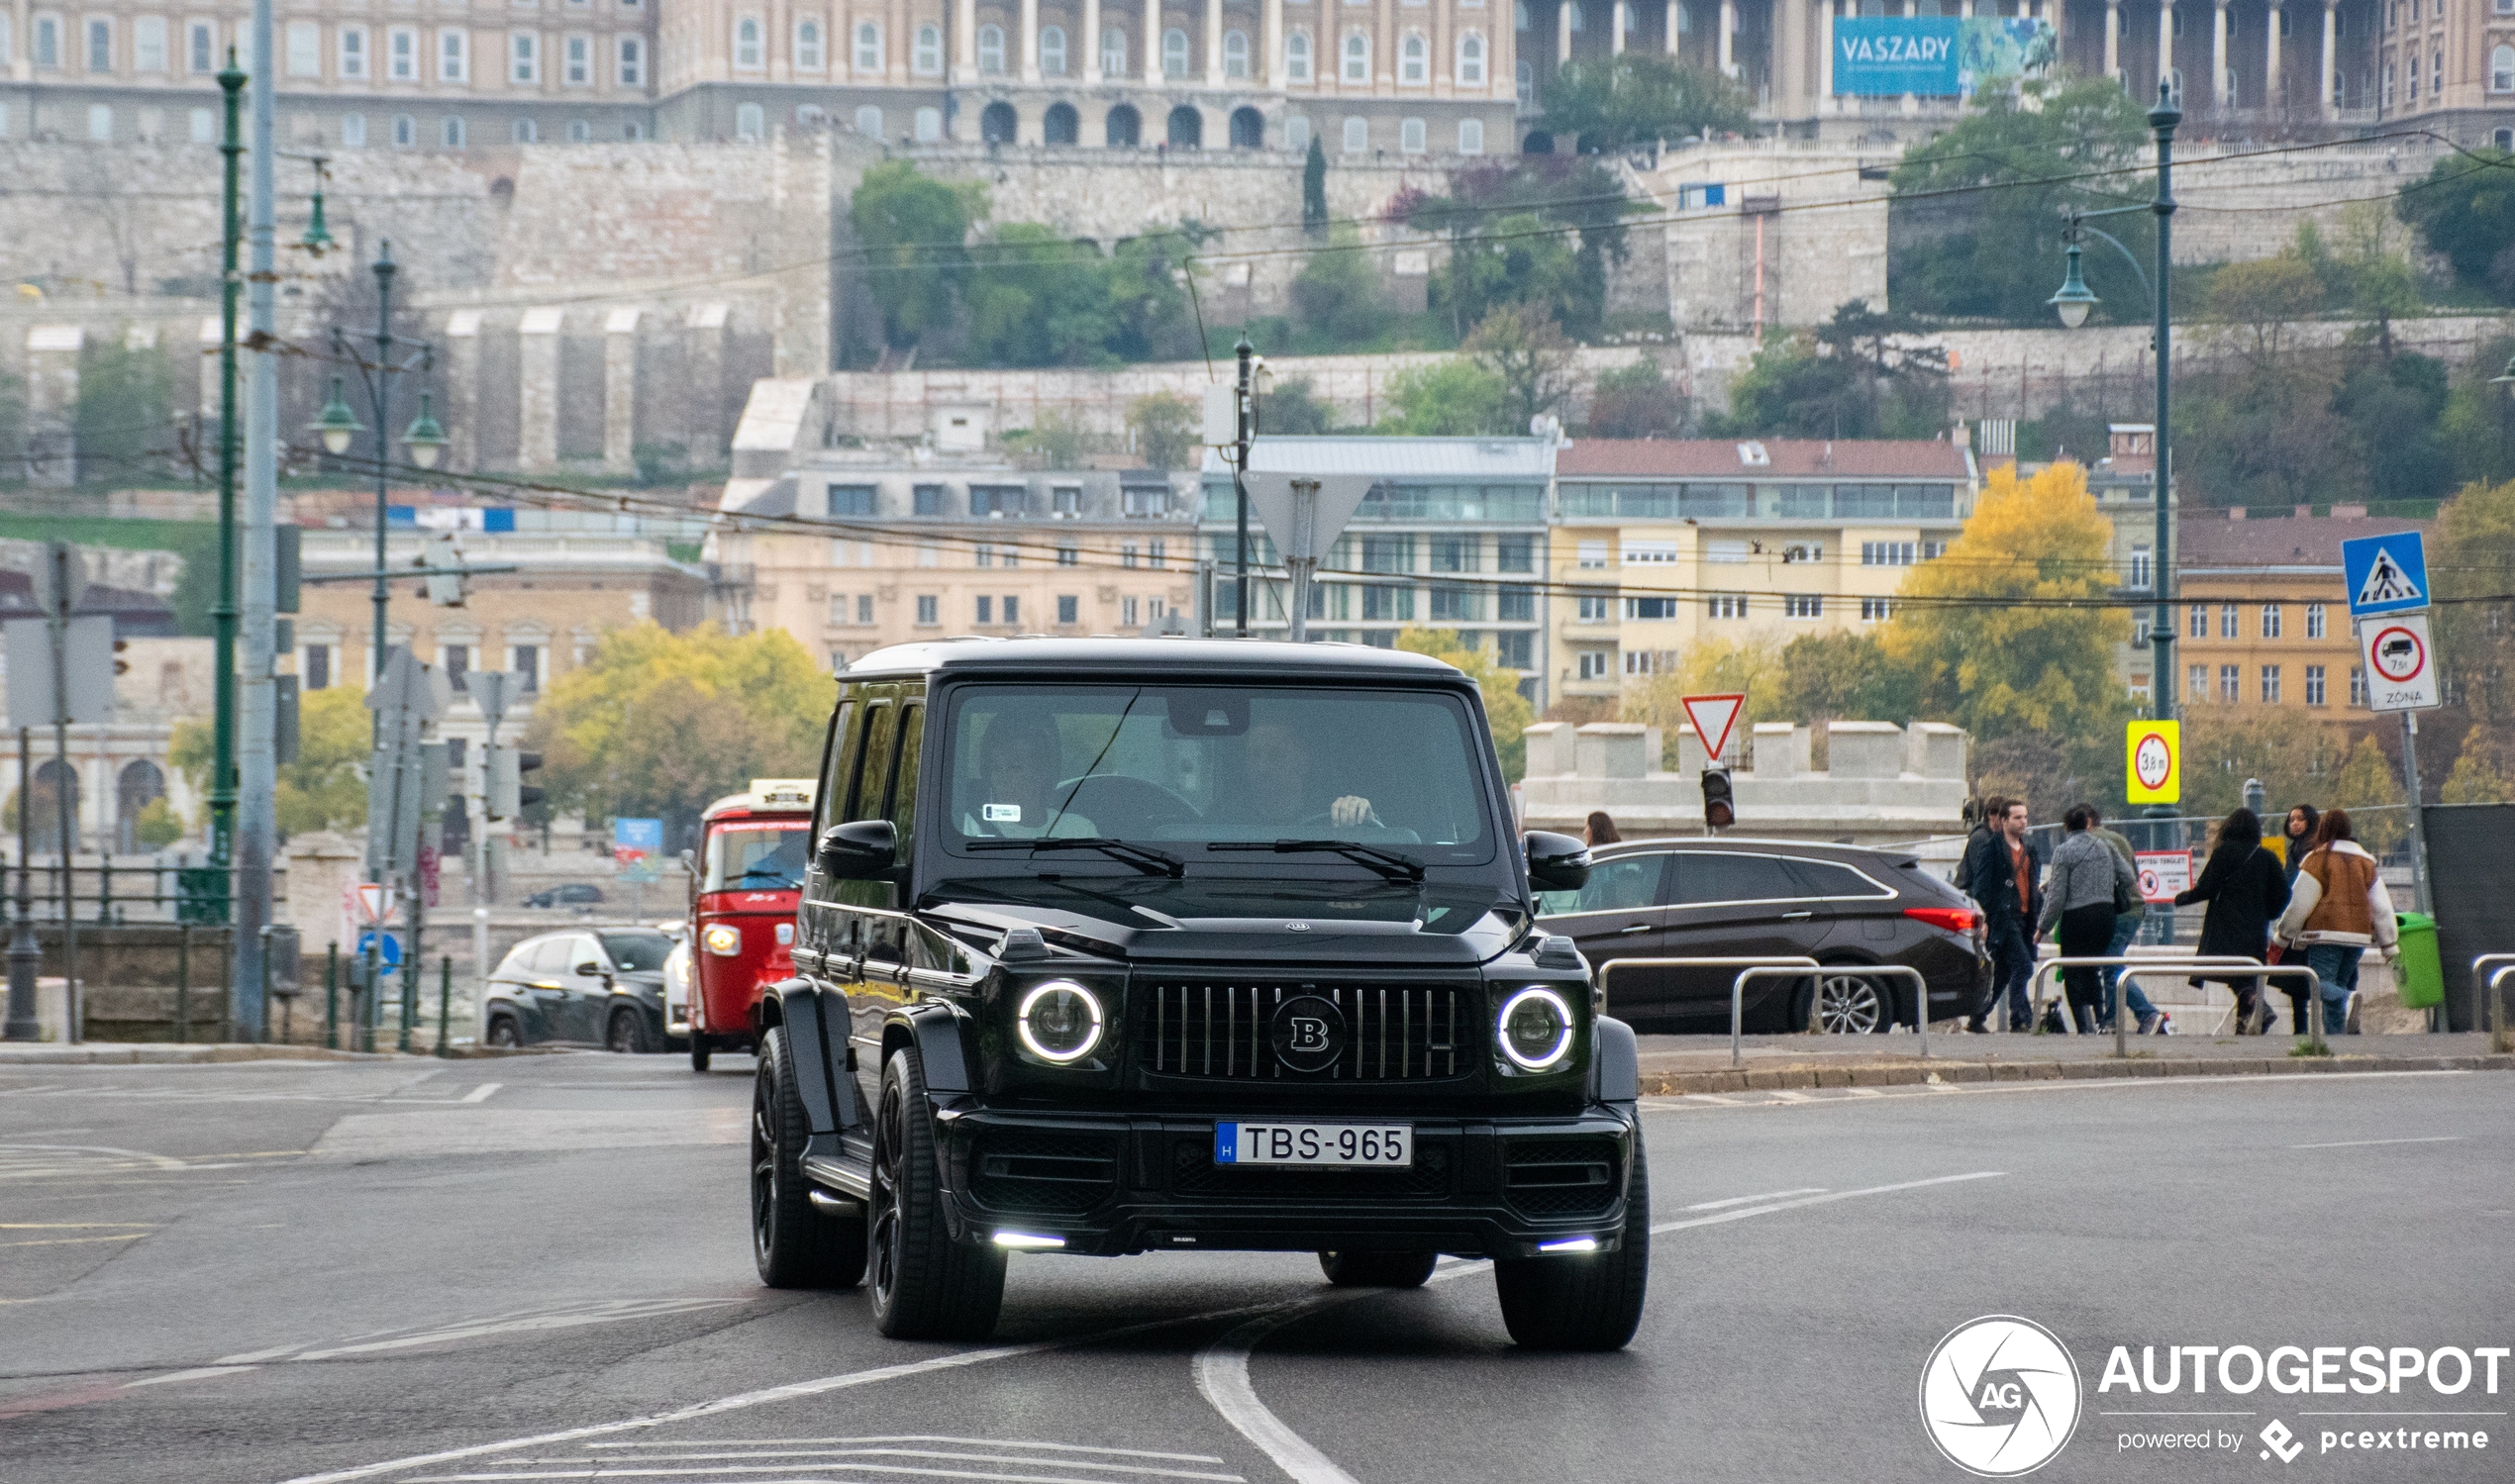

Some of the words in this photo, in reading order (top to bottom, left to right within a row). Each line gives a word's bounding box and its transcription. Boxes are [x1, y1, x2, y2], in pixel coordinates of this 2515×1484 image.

[1842, 36, 1951, 62] VASZARY
[1291, 1017, 1329, 1051] B
[1222, 1145, 1232, 1156] H
[1245, 1128, 1403, 1161] TBS-965
